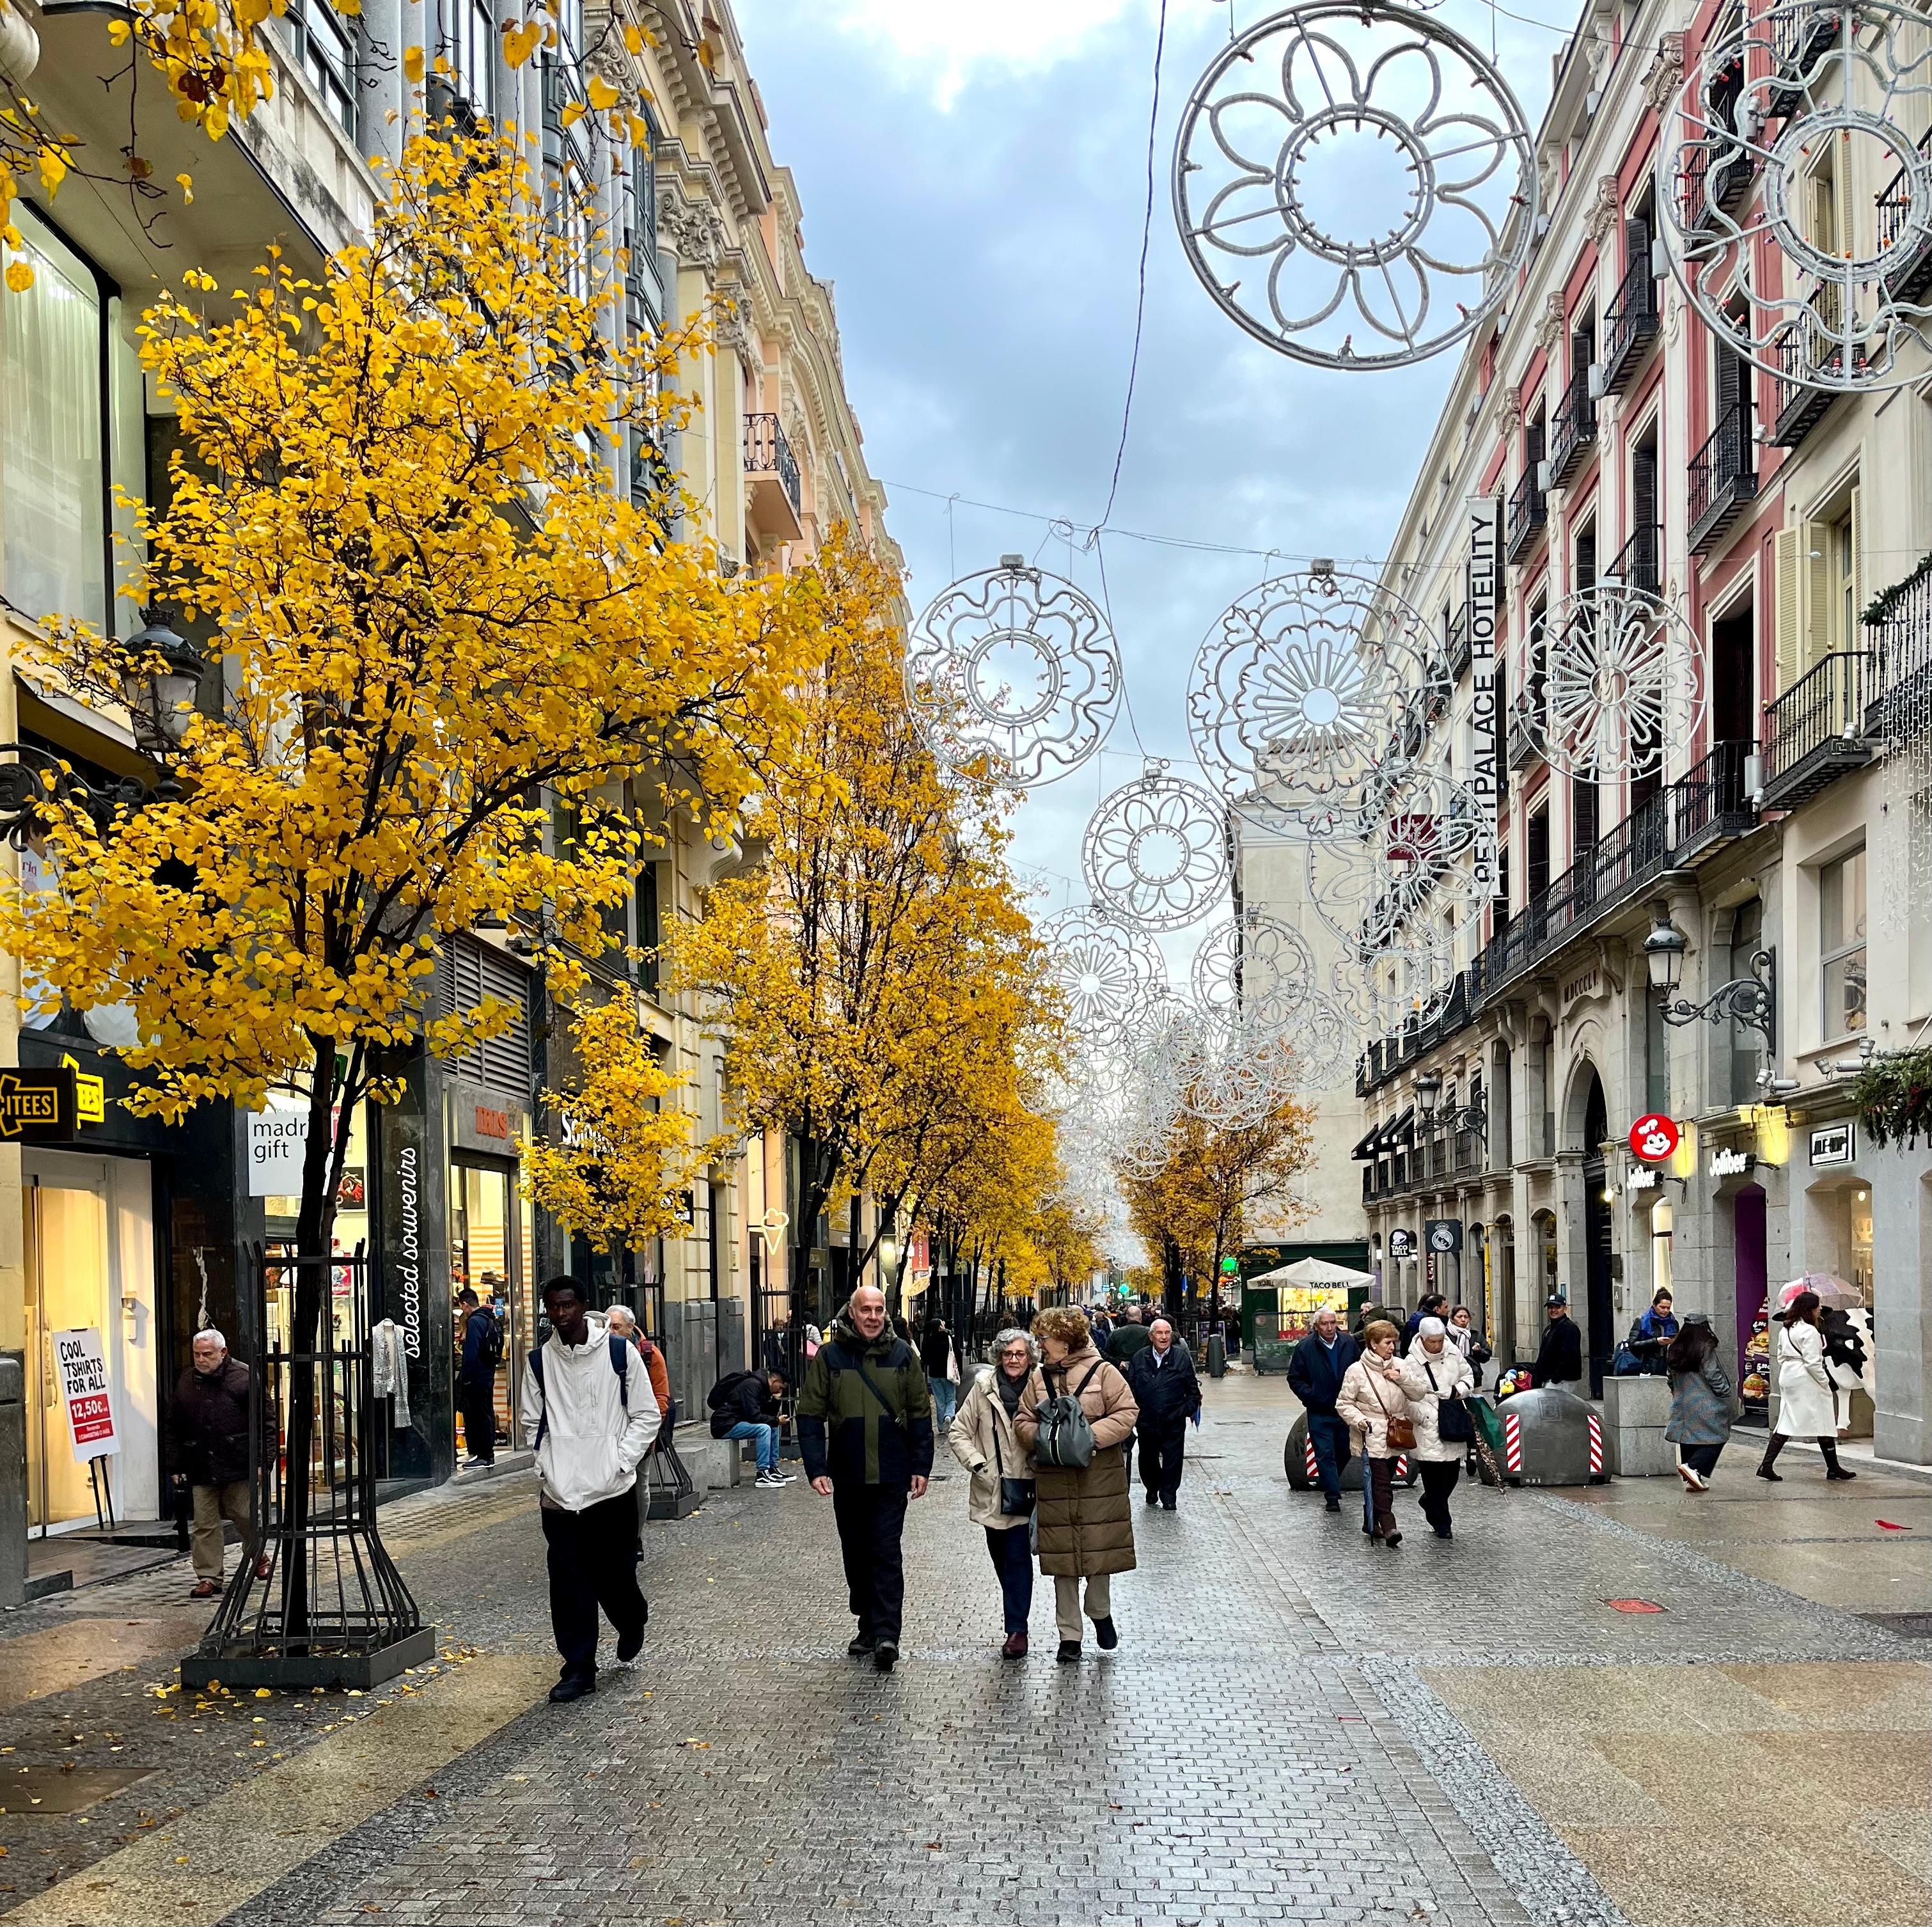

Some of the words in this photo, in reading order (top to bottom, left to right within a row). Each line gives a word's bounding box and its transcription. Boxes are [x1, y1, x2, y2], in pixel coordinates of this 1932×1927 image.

[1472, 514, 1494, 659] HOTELITY
[254, 1140, 289, 1163] gift
[1709, 1147, 1747, 1177] Jollibee
[1627, 1164, 1656, 1190] Jollibee
[397, 1147, 419, 1260] souvenirs
[396, 1264, 420, 1358] selected
[60, 1340, 86, 1362] COOL
[63, 1357, 103, 1378] TSHIRTS
[67, 1378, 86, 1394] FOR
[89, 1374, 106, 1390] ALL
[72, 1400, 103, 1419] 12,50€
